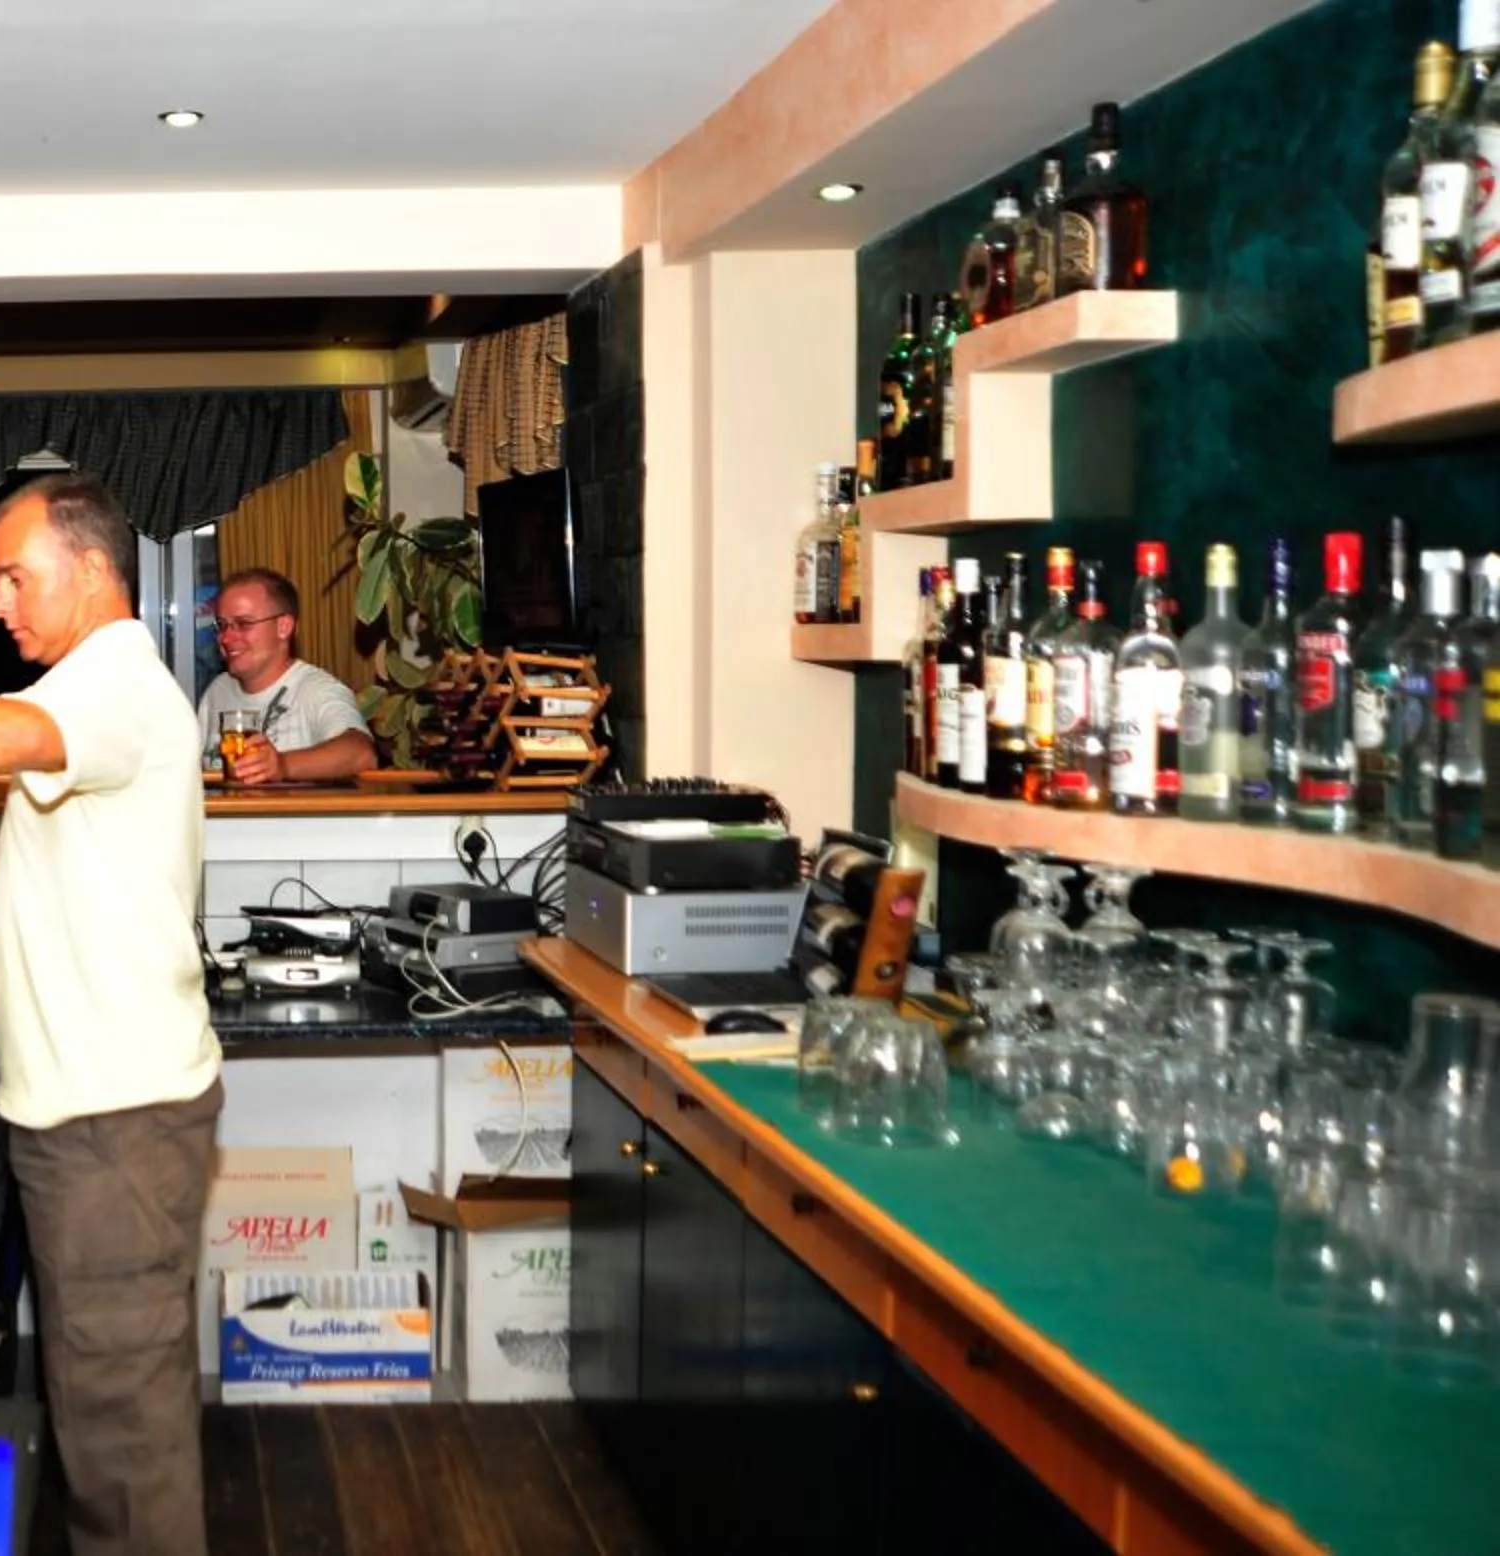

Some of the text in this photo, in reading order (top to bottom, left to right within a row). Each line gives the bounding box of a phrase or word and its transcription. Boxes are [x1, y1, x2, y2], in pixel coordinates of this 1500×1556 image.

[211, 1215, 333, 1248] APELIA
[251, 1360, 411, 1379] Private Reserve Fries
